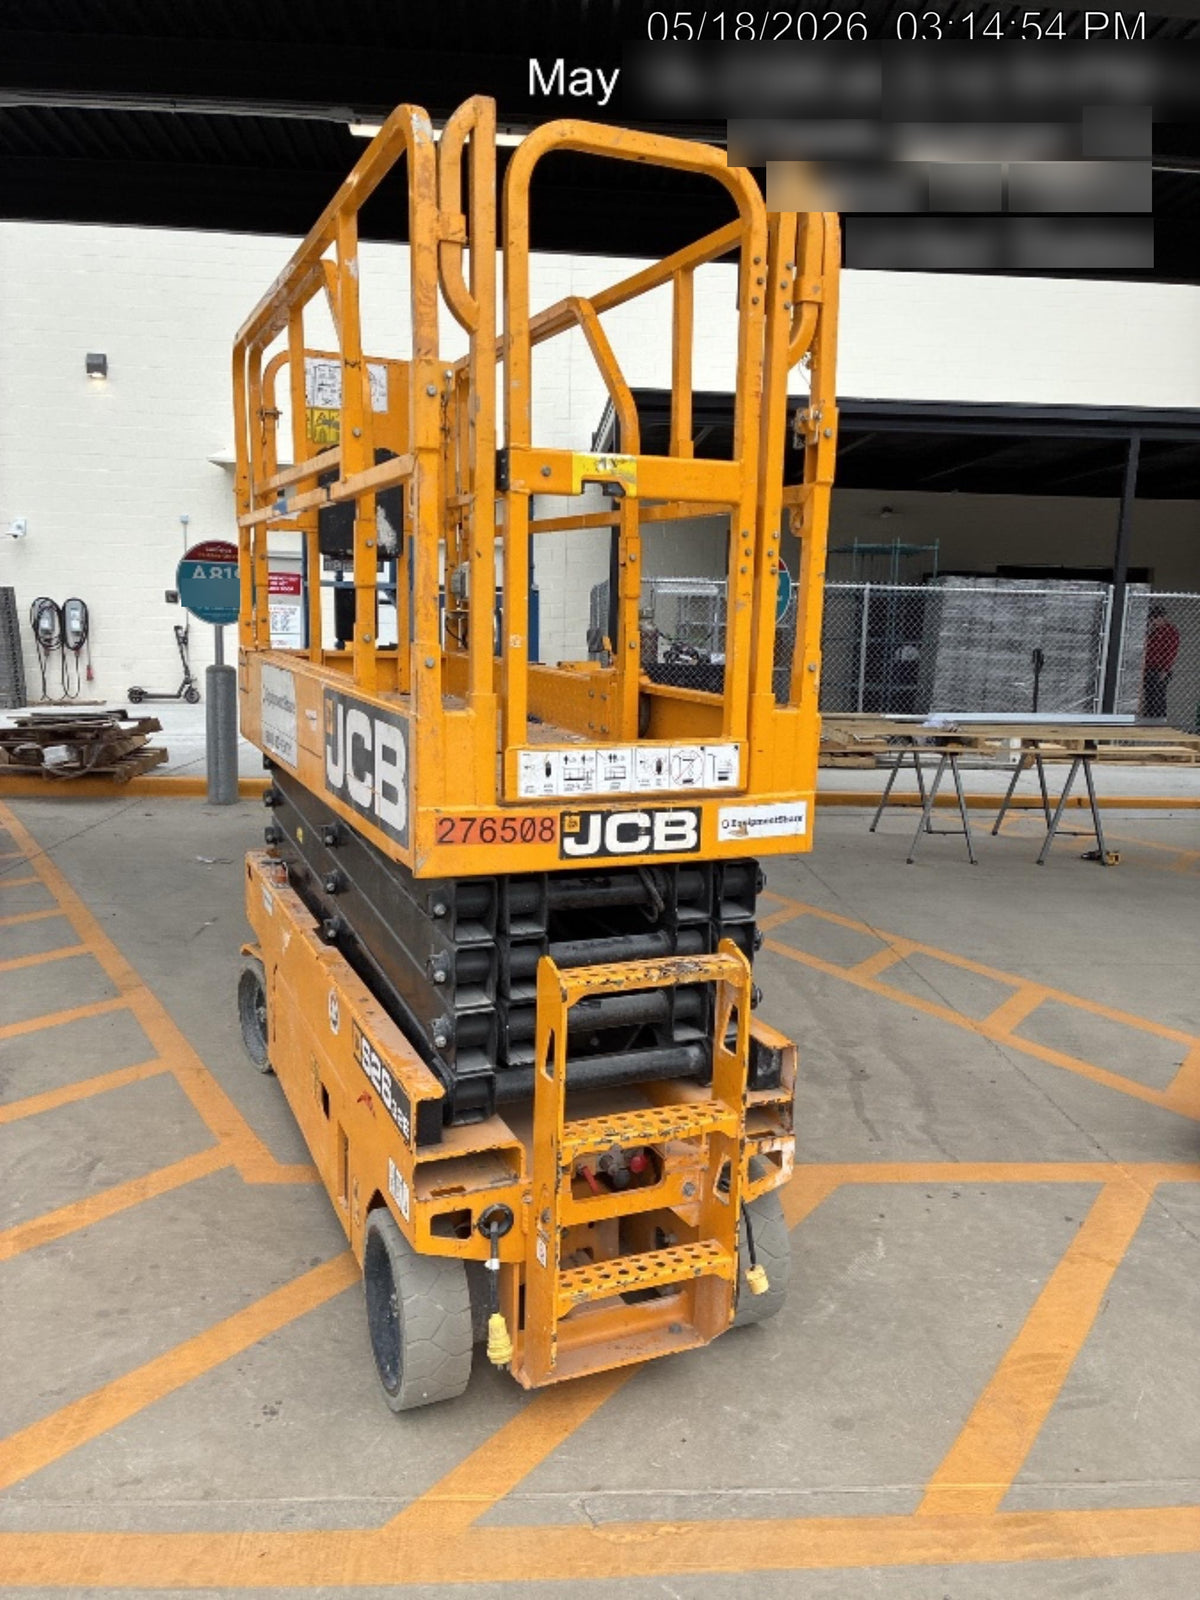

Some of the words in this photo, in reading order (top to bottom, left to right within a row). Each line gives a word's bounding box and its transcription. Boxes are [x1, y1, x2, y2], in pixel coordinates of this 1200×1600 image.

[326, 703, 407, 832] JCB
[437, 816, 556, 844] 276508
[562, 809, 699, 856] JCB
